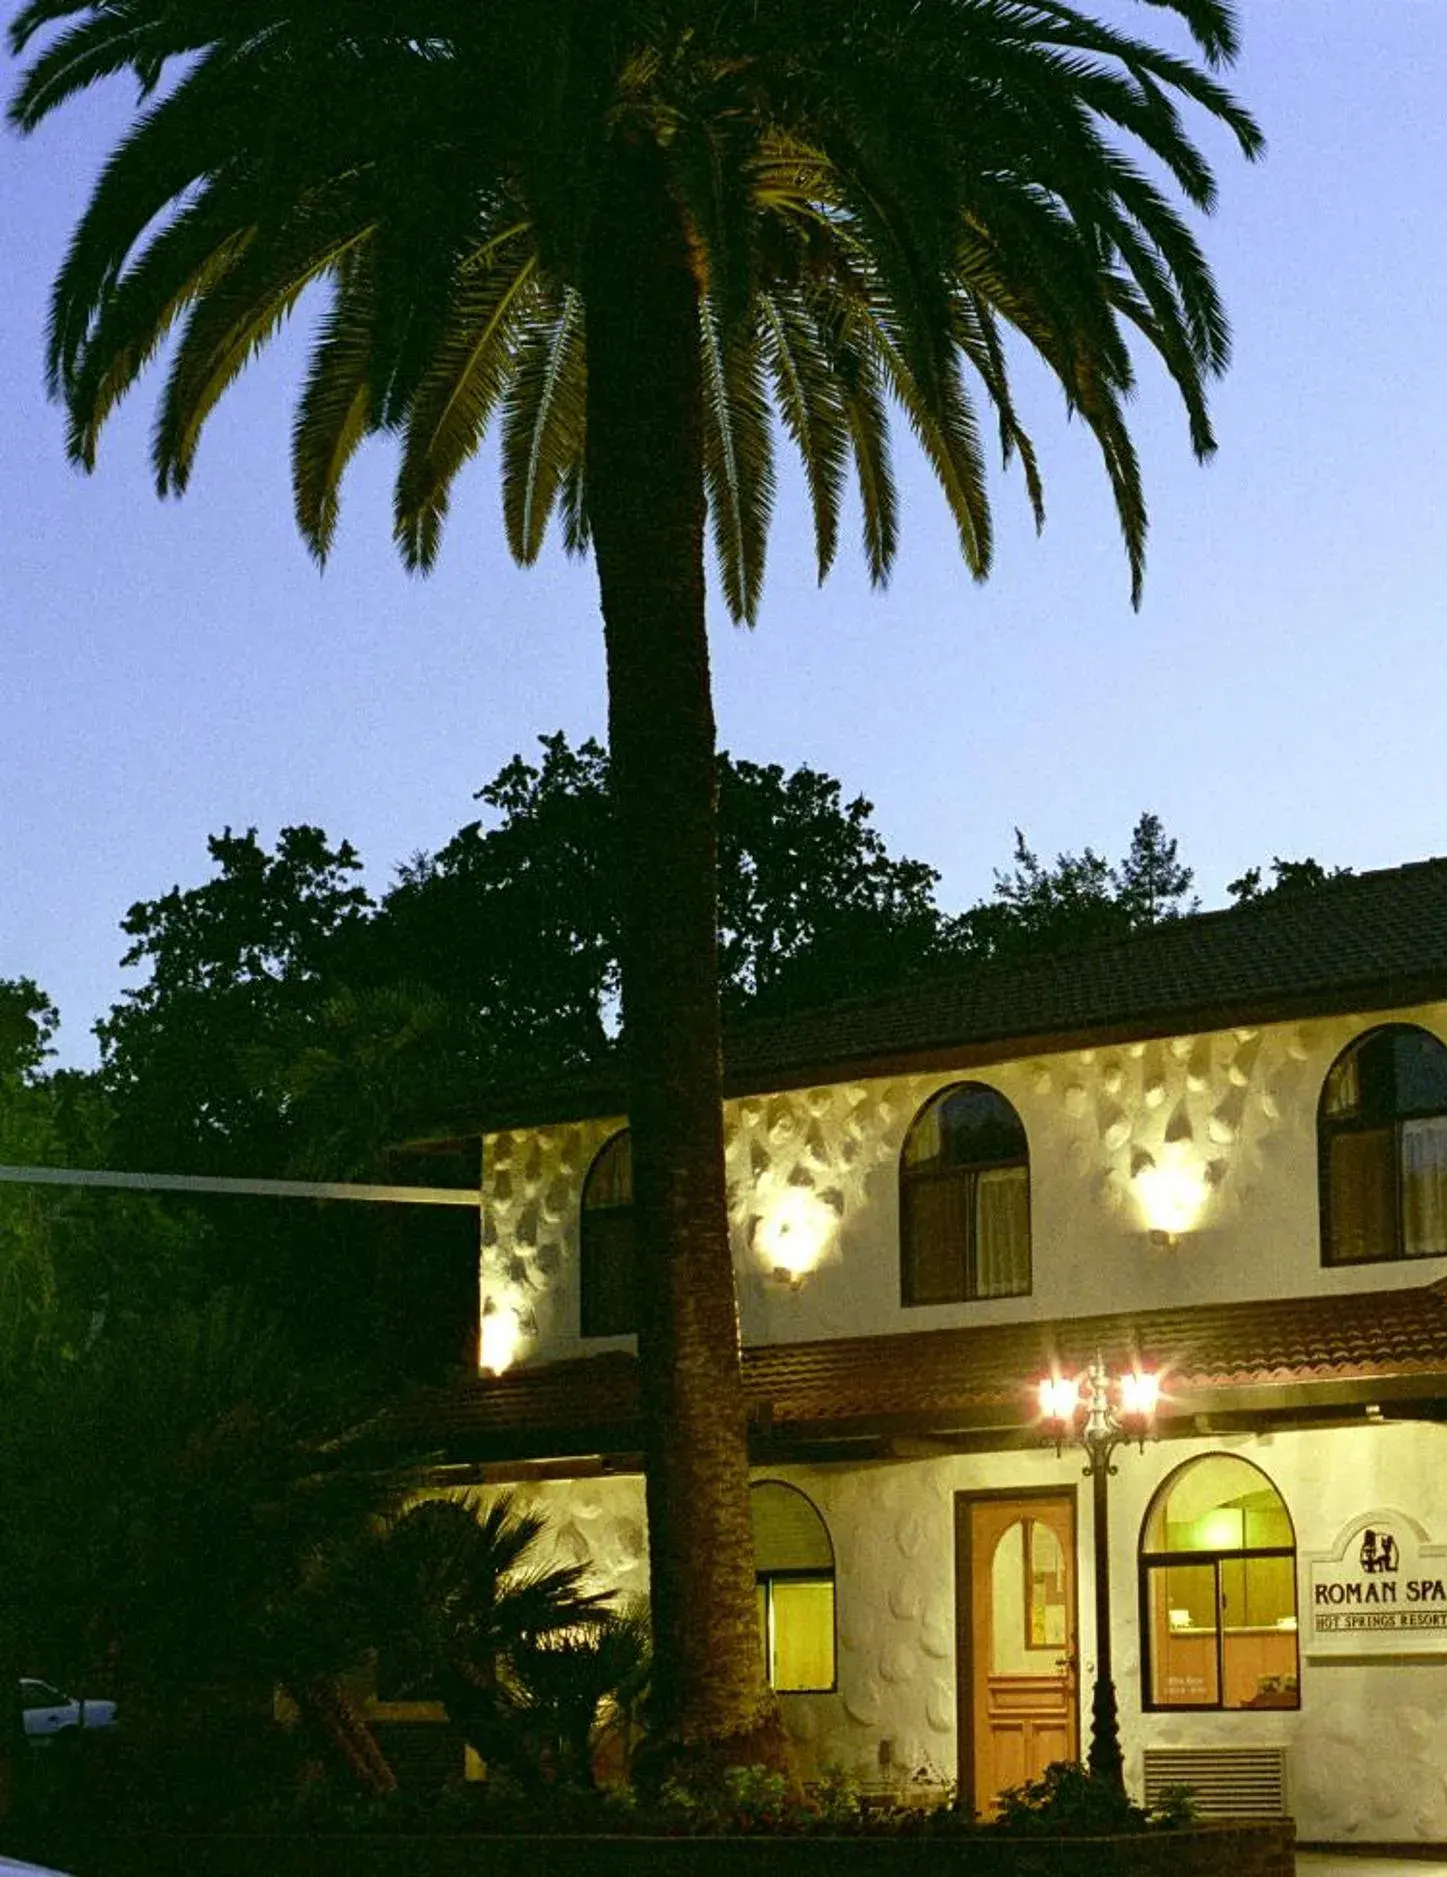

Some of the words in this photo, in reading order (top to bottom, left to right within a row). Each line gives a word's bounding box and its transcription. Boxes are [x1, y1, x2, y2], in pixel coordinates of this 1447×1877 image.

[1315, 1582, 1396, 1604] ROMAN
[1406, 1579, 1447, 1602] SPA
[1316, 1614, 1339, 1630] HOT
[1345, 1613, 1396, 1628] SPRINGS
[1401, 1612, 1447, 1626] RESORT
